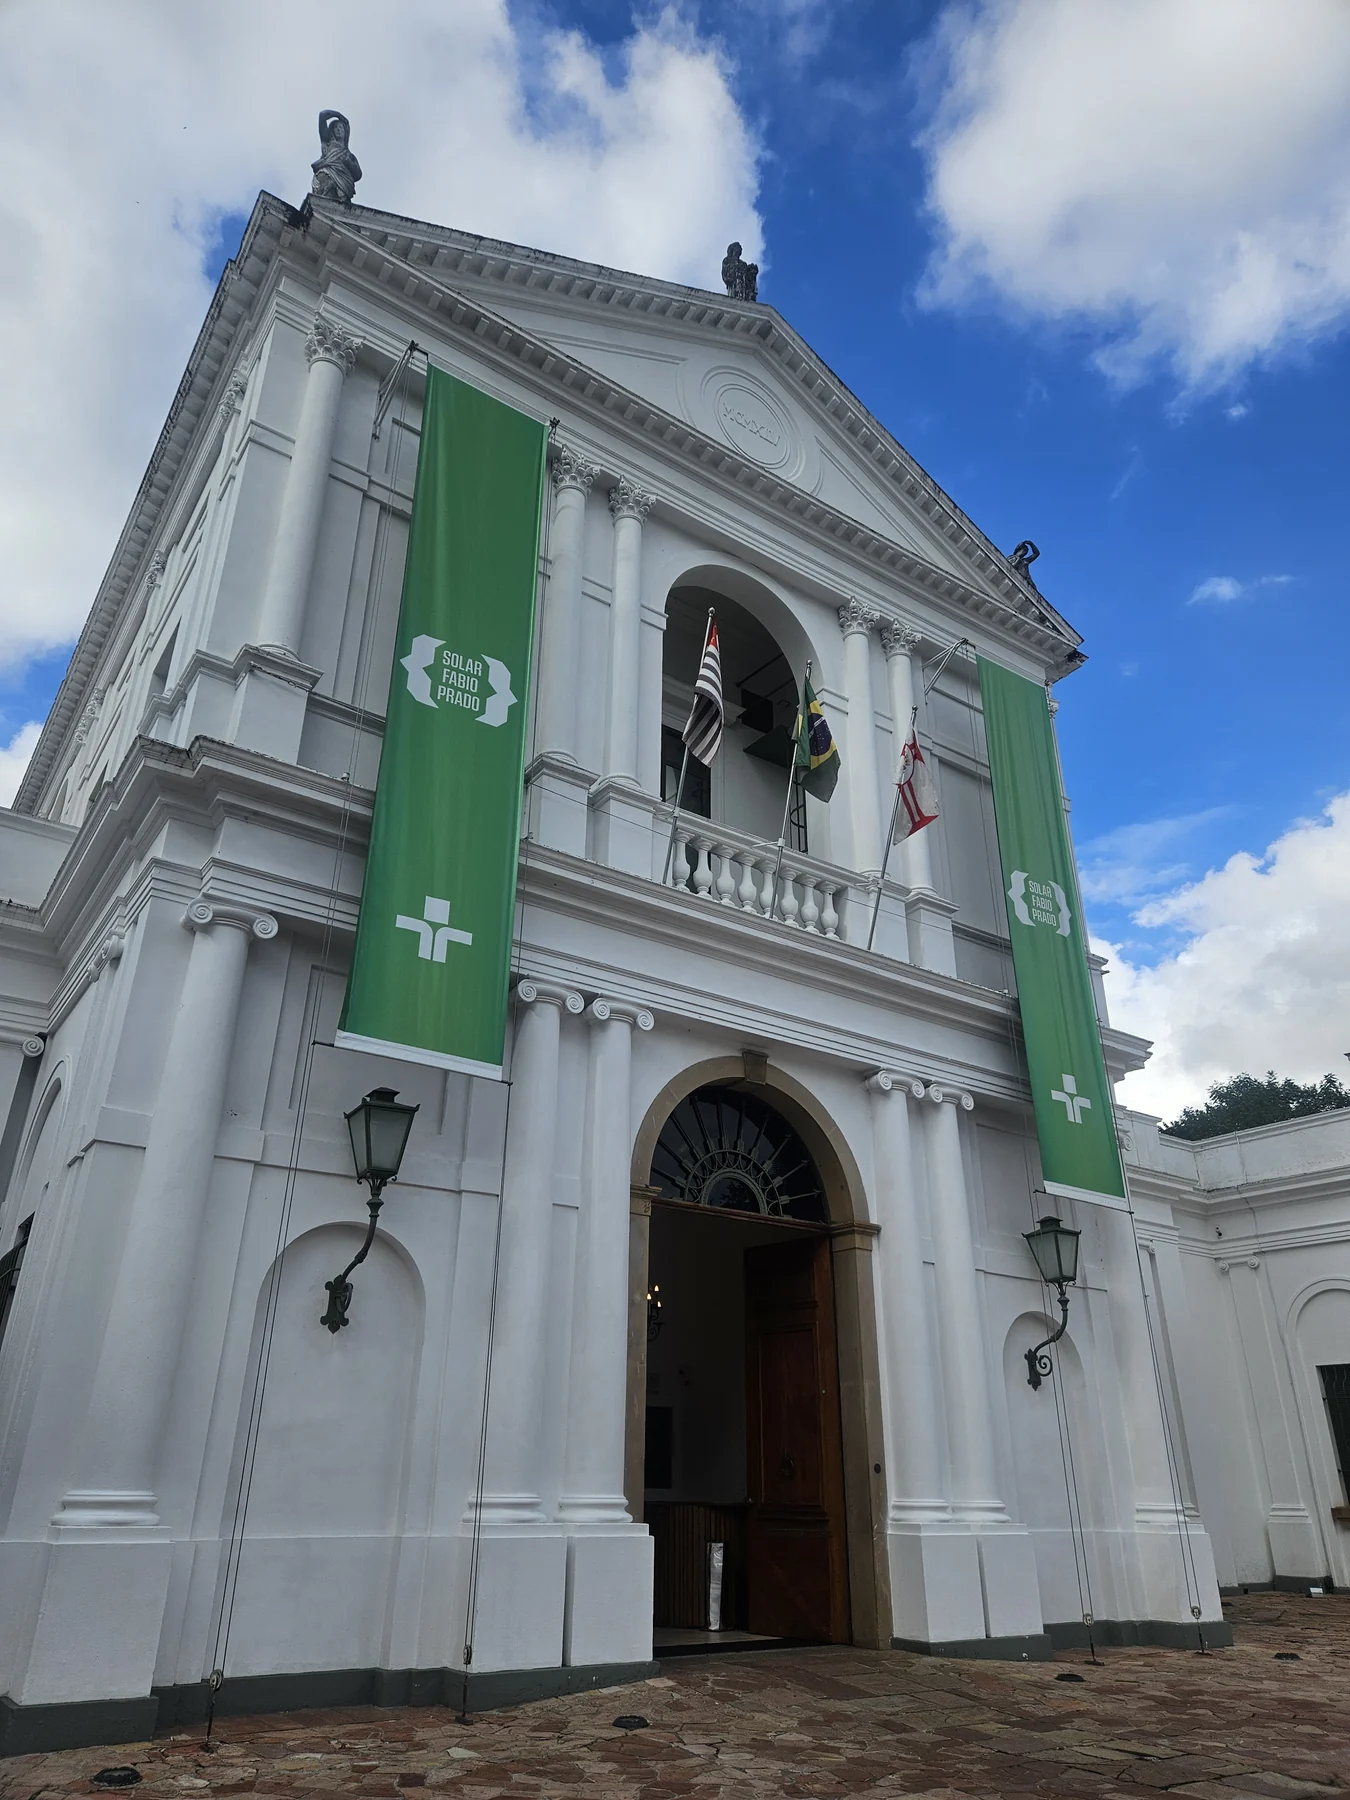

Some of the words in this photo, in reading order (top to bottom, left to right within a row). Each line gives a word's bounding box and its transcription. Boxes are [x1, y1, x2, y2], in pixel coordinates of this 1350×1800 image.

[443, 650, 482, 676] SOLAR
[442, 668, 478, 693] FABIO
[437, 685, 480, 711] PRADO
[1028, 880, 1052, 898] SOLAR
[1031, 895, 1053, 912] FABIO
[1032, 908, 1057, 926] PRADO
